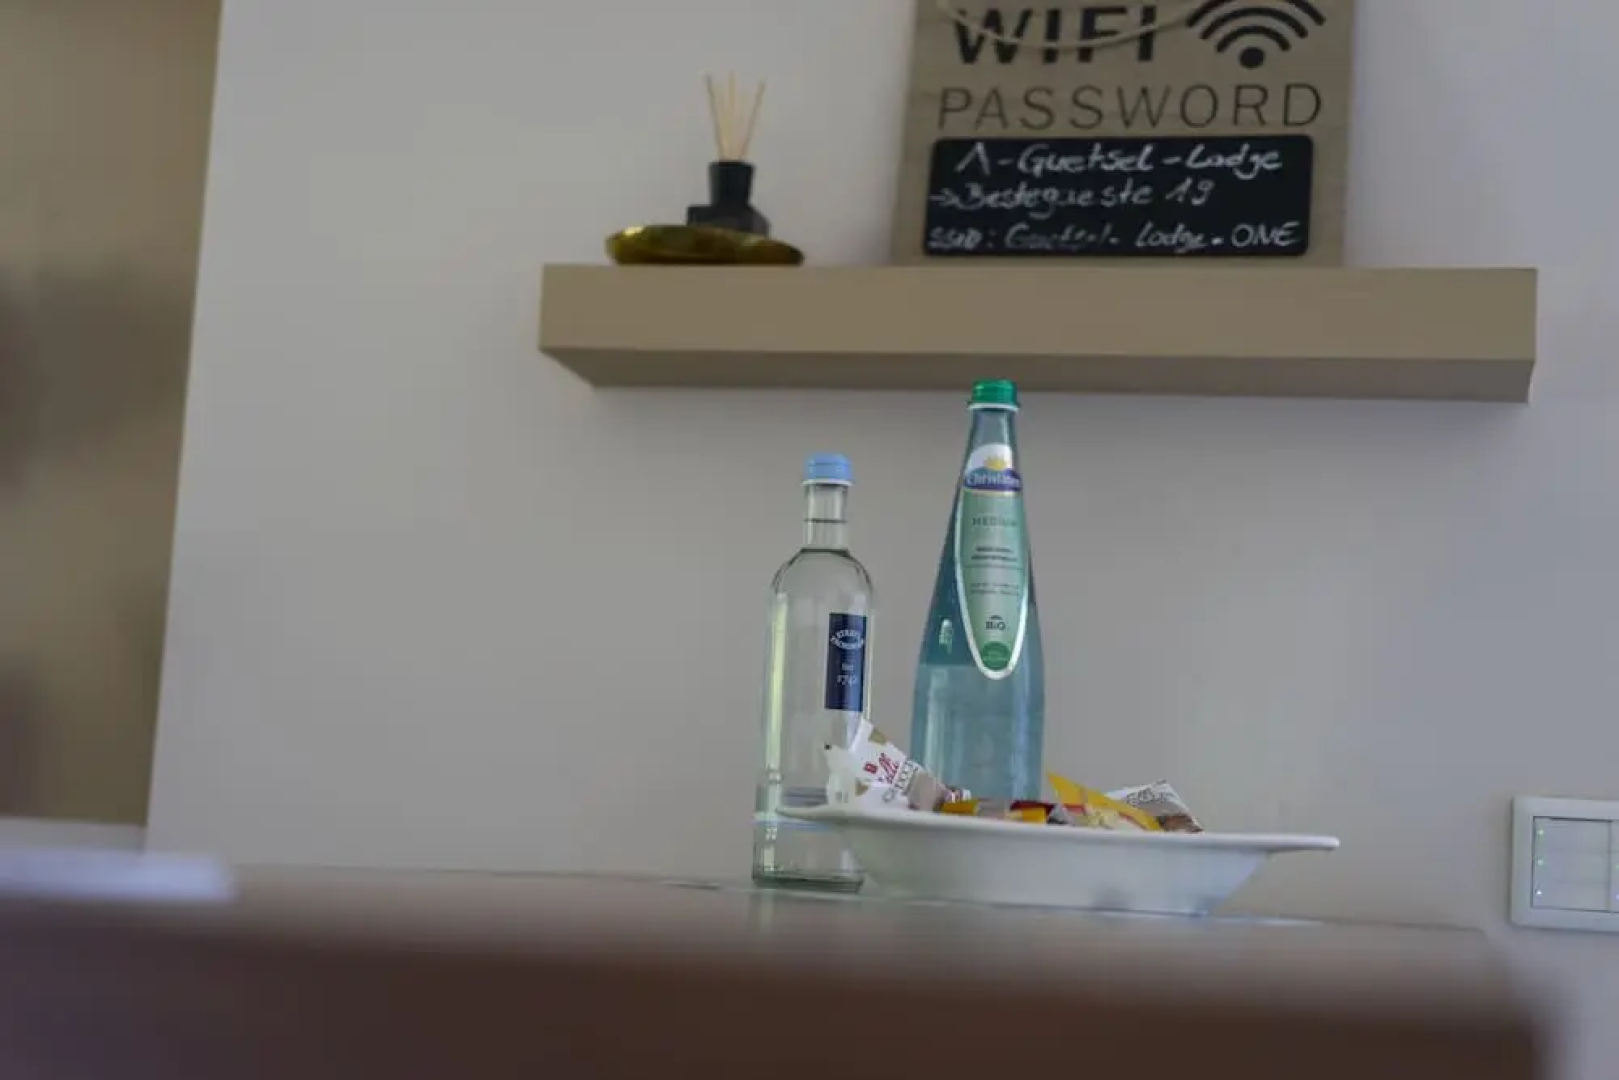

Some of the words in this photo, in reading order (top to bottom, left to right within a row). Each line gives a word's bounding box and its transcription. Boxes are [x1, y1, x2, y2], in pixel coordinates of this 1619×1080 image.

[954, 5, 1157, 65] WIFI
[938, 83, 1322, 130] PASSWORD
[1165, 177, 1216, 205] 19
